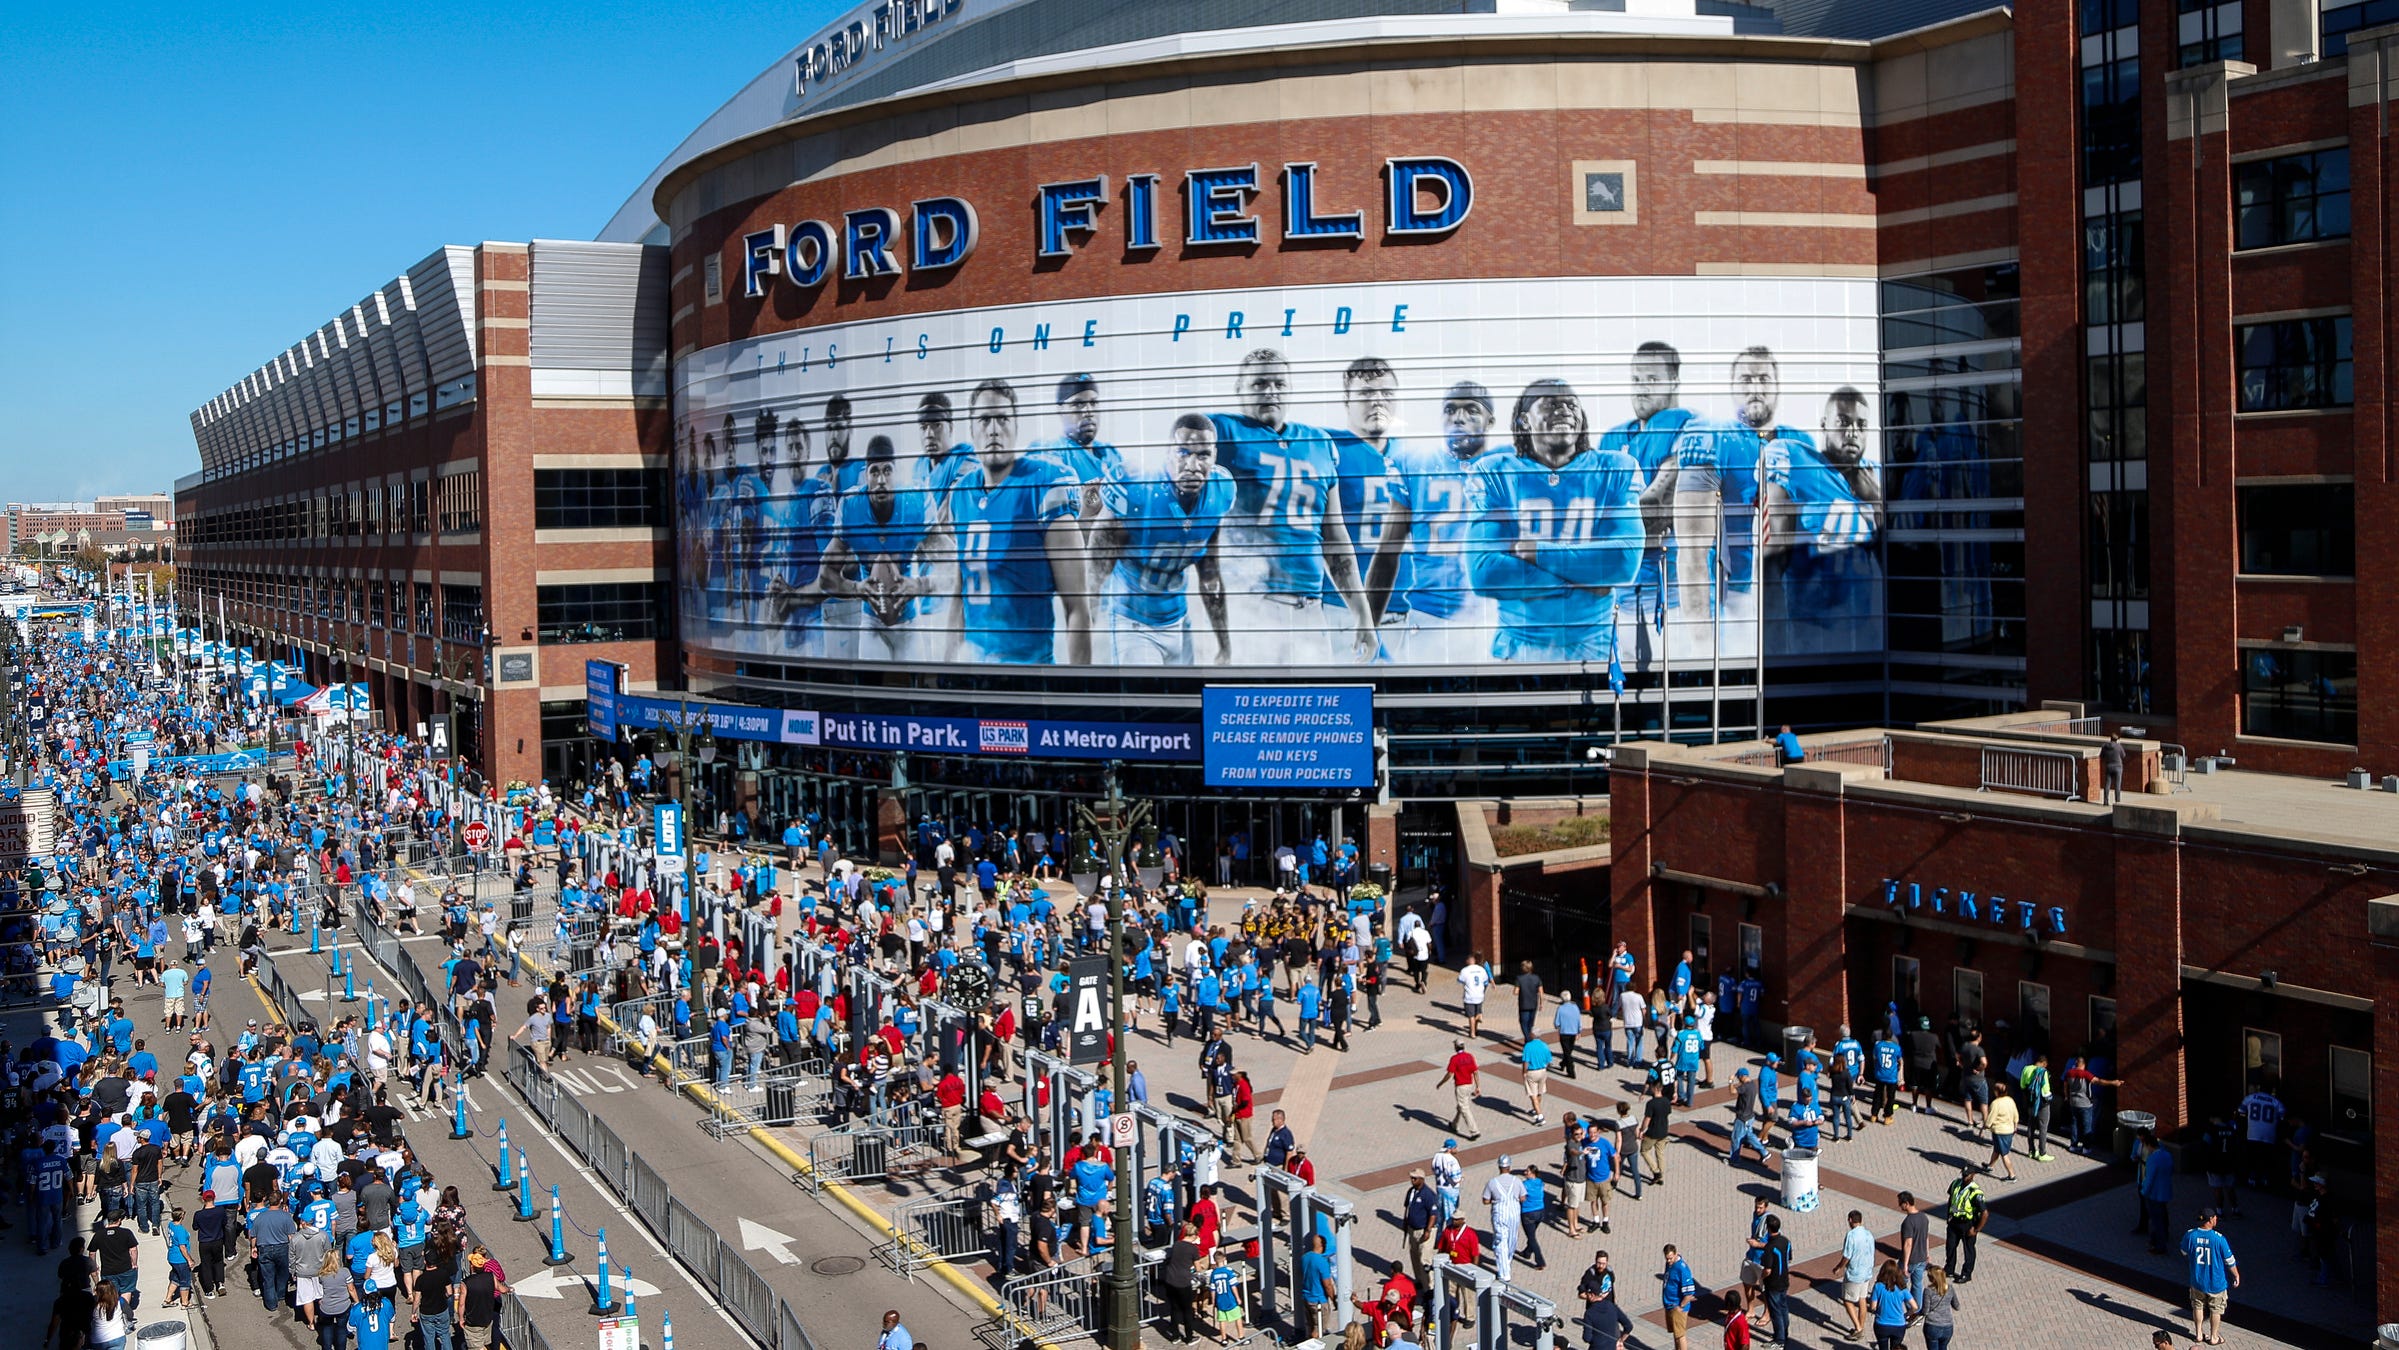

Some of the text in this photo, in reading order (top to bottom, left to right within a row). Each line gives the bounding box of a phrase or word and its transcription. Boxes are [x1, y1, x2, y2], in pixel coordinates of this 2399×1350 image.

[796, 21, 869, 96] FORD
[743, 155, 1474, 298] FORD FIELD
[757, 304, 1409, 377] THIS IS ONE PRIDE
[1258, 454, 1319, 531] 76
[1358, 476, 1393, 549] 6
[1426, 480, 1464, 557] 2
[963, 519, 992, 606] 9
[1234, 695, 1340, 707] TO EXPEDITE THE
[738, 717, 769, 732] 4:30PM
[787, 717, 815, 736] HOME
[1220, 713, 1354, 726] SCREENING PROCESS,
[432, 728, 448, 747] A
[824, 718, 968, 748] Put it in Park.
[982, 728, 1026, 743] US PARK
[1040, 729, 1191, 752] At Metro Airport
[1212, 731, 1364, 744] PLEASE REMOVE PHONES
[1257, 750, 1318, 762] AND KEYS
[1221, 767, 1352, 780] FROM YOUR POCKETS
[465, 828, 488, 840] STOP
[661, 809, 677, 853] LIONS
[207, 836, 216, 848] 15
[1882, 878, 2066, 934] TICKETS
[1078, 975, 1099, 986] GATE
[1073, 986, 1104, 1033] A
[1684, 1039, 1699, 1053] 68
[1847, 1050, 1856, 1066] 9
[1881, 1053, 1893, 1069] 15
[249, 1073, 258, 1088] 9
[545, 1063, 639, 1098] NLY
[2249, 1102, 2275, 1123] 80
[38, 1169, 64, 1191] 20
[315, 1209, 328, 1229] 9
[2196, 1246, 2211, 1266] 21
[368, 1312, 379, 1333] 9
